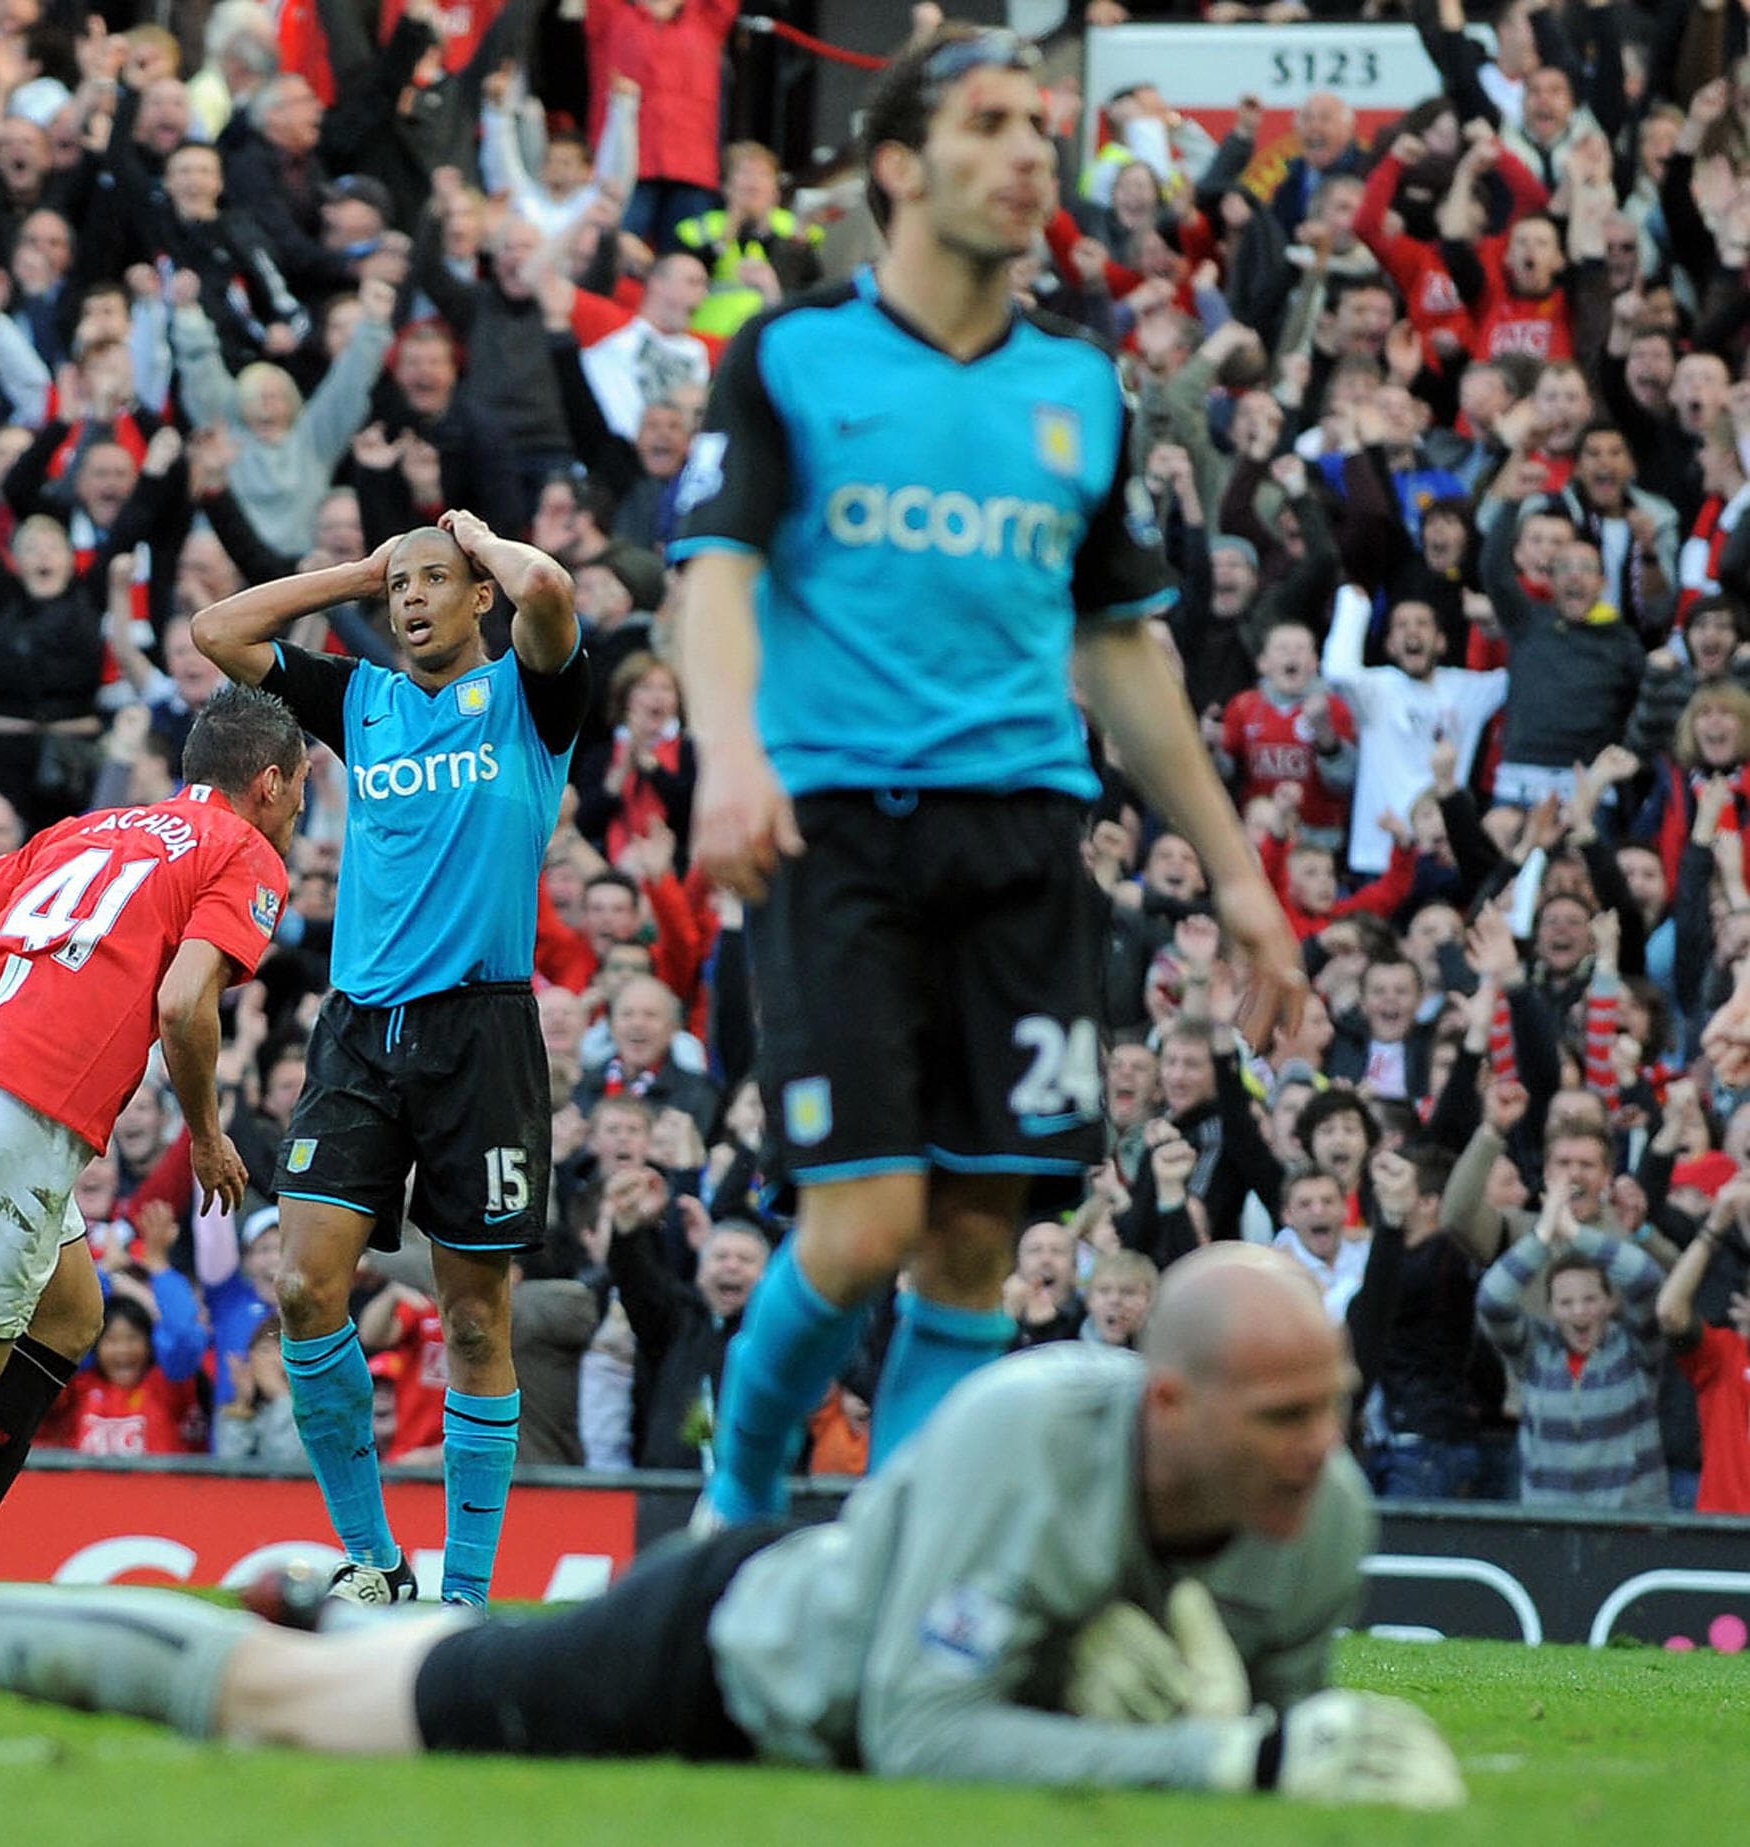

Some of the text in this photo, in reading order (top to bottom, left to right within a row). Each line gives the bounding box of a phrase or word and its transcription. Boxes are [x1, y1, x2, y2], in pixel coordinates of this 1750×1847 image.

[1272, 51, 1377, 84] S123
[80, 809, 198, 863] ACHEDA
[0, 847, 160, 972] 41
[1009, 1014, 1100, 1121] 24
[484, 1146, 529, 1211] 15
